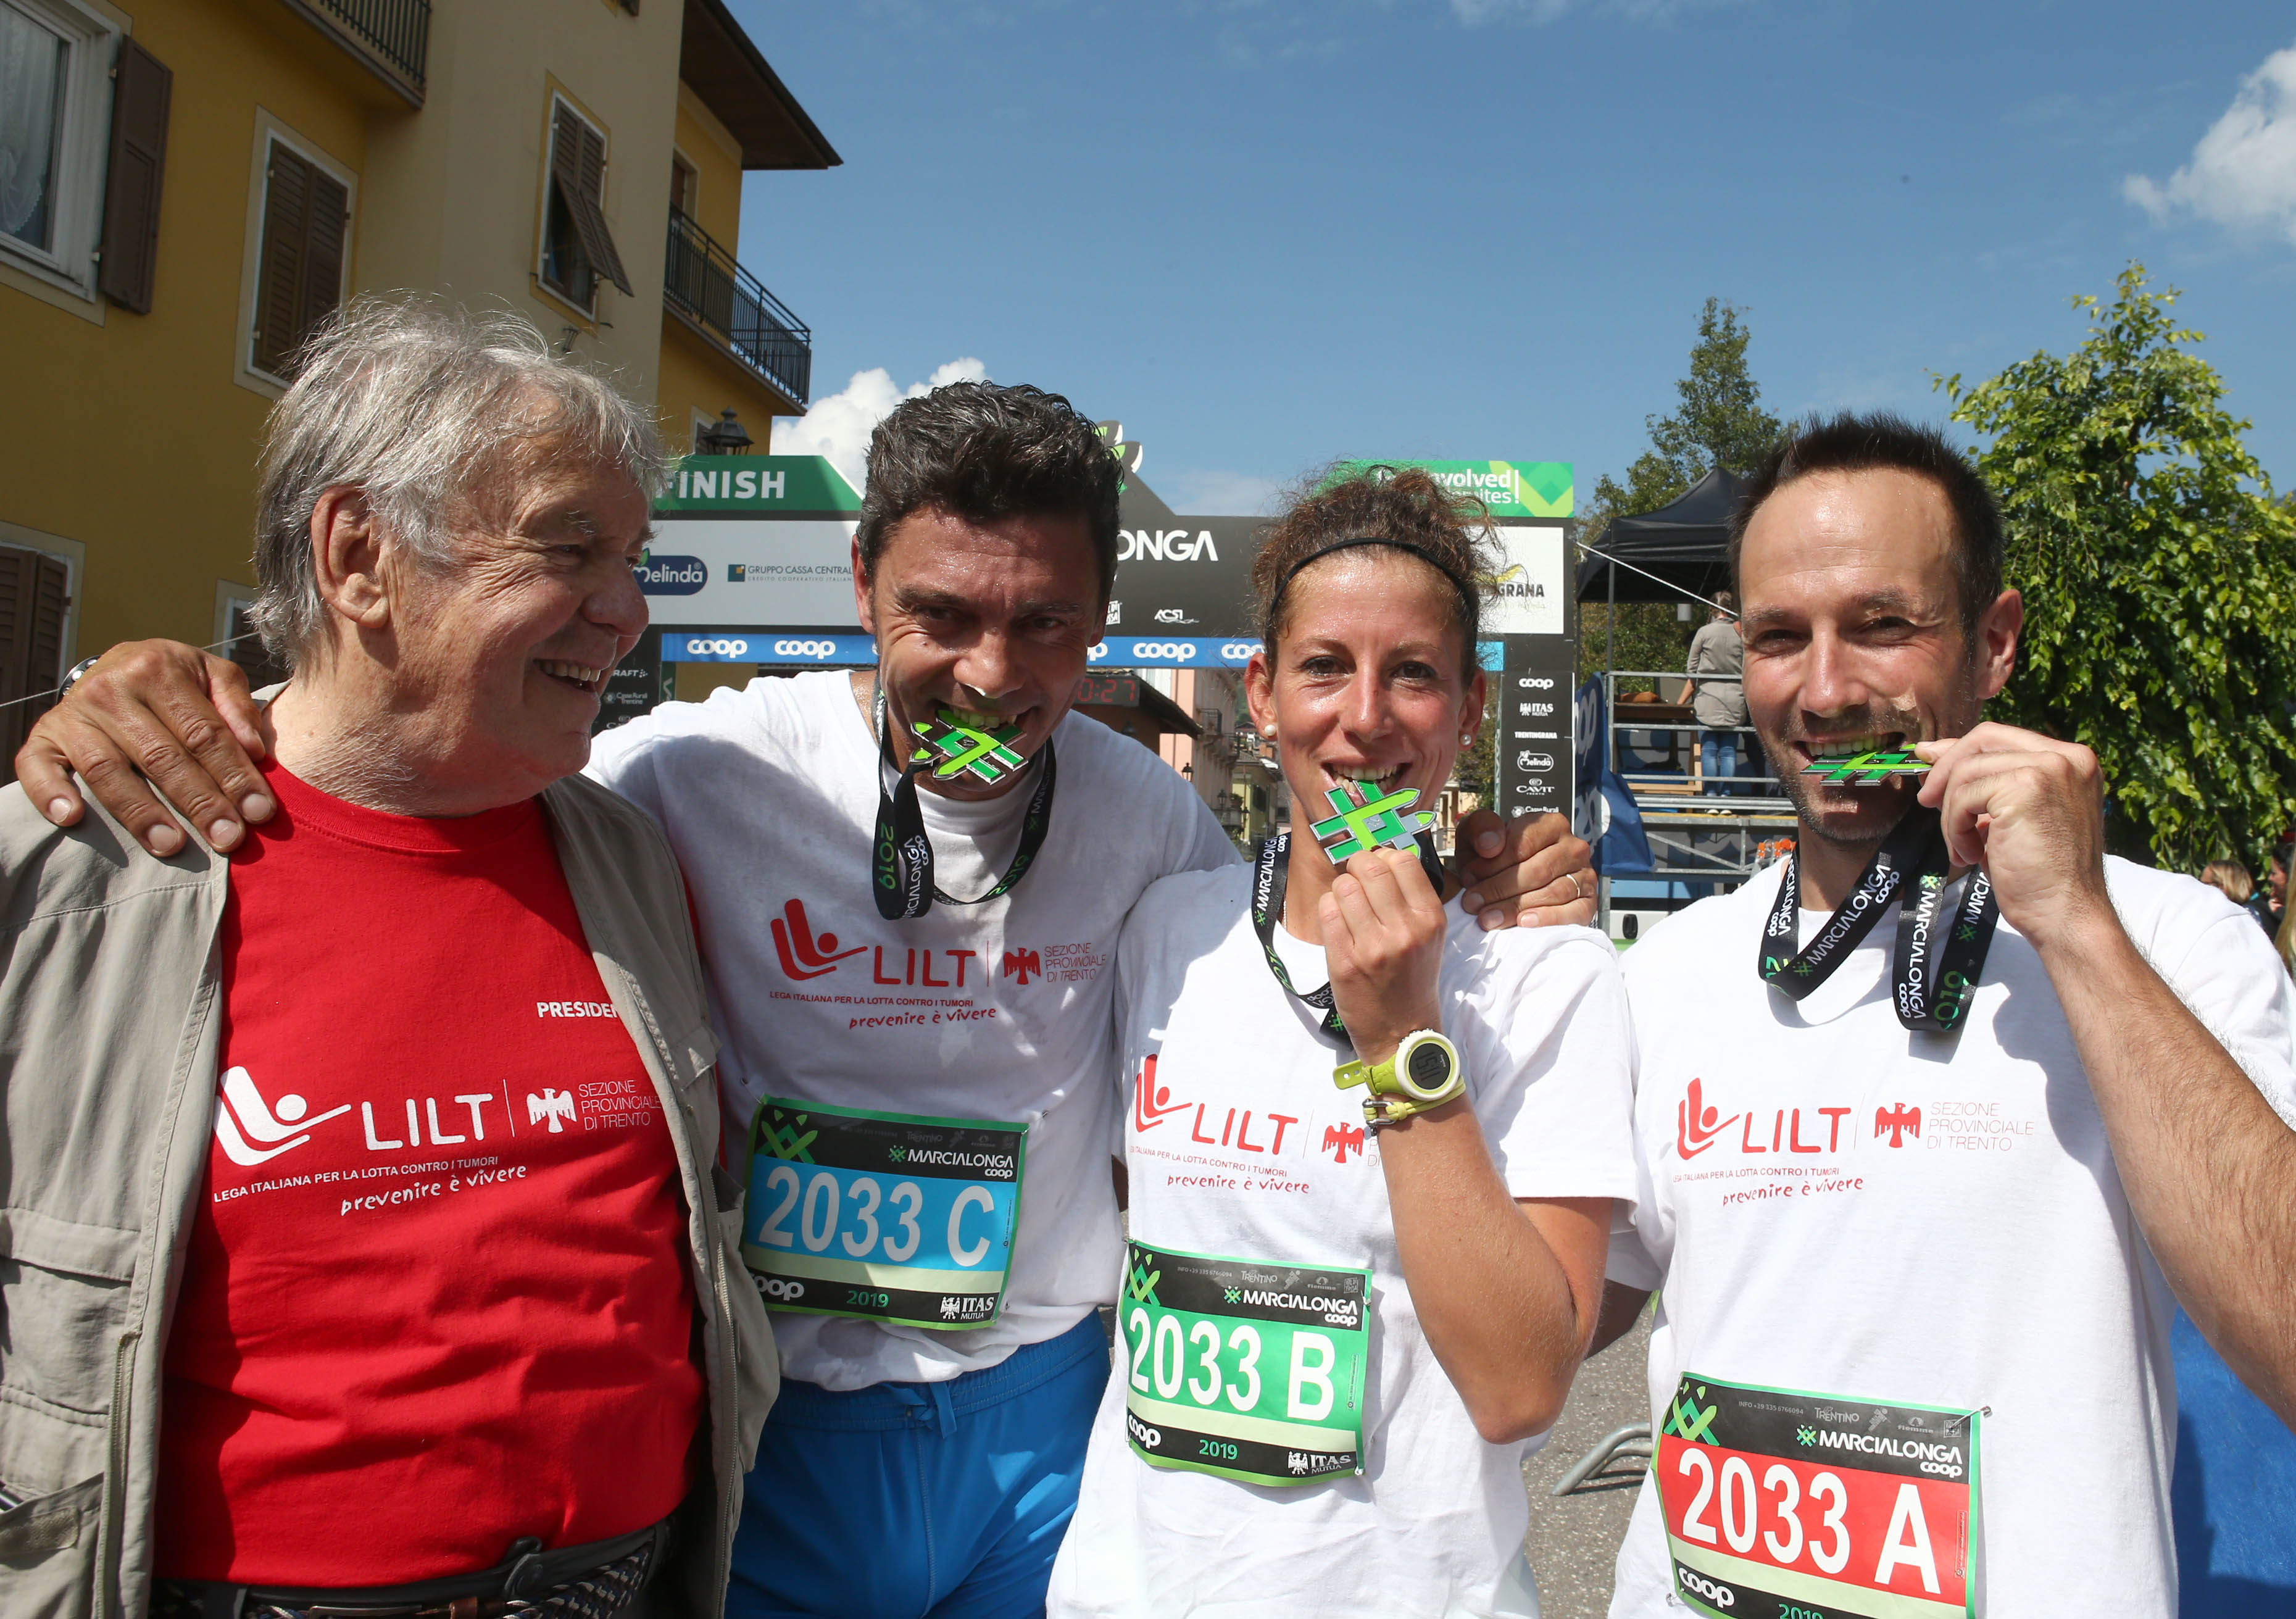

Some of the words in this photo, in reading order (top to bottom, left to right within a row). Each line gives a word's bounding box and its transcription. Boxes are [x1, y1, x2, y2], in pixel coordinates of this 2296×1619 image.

[748, 566, 784, 574] GRUPPO
[785, 566, 813, 574] CASSA
[687, 639, 747, 658] coop
[774, 639, 836, 659] coop
[1133, 643, 1196, 662] coop
[1518, 678, 1554, 690] coop
[1532, 703, 1554, 712] ITAS
[1520, 757, 1552, 766] Melinda
[1516, 785, 1555, 793] CAVIT
[1277, 835, 1288, 852] coop
[879, 822, 896, 889] 2019
[1875, 871, 1900, 904] coop
[1807, 863, 1892, 965] MARCIALONGA
[1768, 912, 1779, 937] coop
[1044, 943, 1091, 957] SEZIONE
[1909, 891, 1936, 1018] MARCIALONGA
[874, 946, 976, 988] LILT
[1046, 954, 1106, 969] PROVINCIALE
[1047, 972, 1057, 983] DI
[1060, 968, 1096, 982] TRENTO
[770, 991, 791, 1000] LEGA
[793, 993, 833, 1004] ITALIANA
[834, 996, 852, 1004] PER
[854, 996, 865, 1004] LA
[867, 997, 894, 1005] LOTTA
[896, 998, 932, 1007] CONTRO
[939, 999, 973, 1007] TUMORI
[1899, 983, 1911, 1018] coop
[849, 1012, 925, 1030] prevenire
[932, 1010, 941, 1023] è
[947, 1007, 997, 1022] vivere
[578, 1080, 637, 1097] SEZIONE
[1931, 1102, 2000, 1116] SEZIONE
[361, 1093, 494, 1151] LILT
[584, 1117, 597, 1131] DI
[599, 1112, 651, 1129] TRENTO
[1192, 1102, 1299, 1155] LILT
[1742, 1107, 1852, 1154] LILT
[1929, 1118, 2035, 1135] PROVINCIALE
[1927, 1135, 1942, 1149] DI
[1948, 1136, 2012, 1151] TRENTO
[907, 1149, 1013, 1168] MARCIALONGA
[1157, 1151, 1170, 1159] PER
[1172, 1152, 1181, 1161] LA
[1183, 1155, 1207, 1165] LOTTA
[1210, 1159, 1246, 1172] CONTRO
[1253, 1165, 1287, 1177] TUMORI
[214, 1188, 249, 1203] LEGA
[251, 1176, 312, 1194] ITALIANA
[314, 1171, 338, 1184] PER
[343, 1169, 360, 1180] LA
[362, 1165, 399, 1178] LOTTA
[401, 1161, 449, 1175] CONTRO
[457, 1156, 499, 1169] TUMORI
[984, 1168, 1013, 1179] coop
[1710, 1171, 1724, 1179] PER
[1725, 1170, 1734, 1178] LA
[1736, 1168, 1758, 1178] LOTTA
[1760, 1167, 1803, 1176] CONTRO
[1811, 1167, 1840, 1176] TUMORI
[340, 1181, 442, 1217] prevenire
[449, 1175, 460, 1192] è
[467, 1163, 527, 1188] vivere
[1167, 1174, 1236, 1190] prevenire
[1244, 1176, 1252, 1190] è
[1258, 1178, 1310, 1194] vivere
[1723, 1183, 1793, 1207] prevenire
[1802, 1181, 1811, 1196] è
[1816, 1177, 1864, 1192] vivere
[759, 1166, 923, 1262] 2033
[947, 1185, 995, 1267] C
[1241, 1270, 1278, 1284] TRENTINO
[846, 1289, 889, 1308] 2019
[962, 1296, 995, 1313] ITAS
[1243, 1289, 1358, 1315] MARCIALONGA
[960, 1312, 984, 1320] MUTUA
[1325, 1313, 1358, 1327] coop
[1129, 1307, 1262, 1412] 2033
[1286, 1330, 1336, 1421] B
[1739, 1400, 1753, 1409] INFO
[1753, 1402, 1765, 1410] +39
[1765, 1403, 1778, 1412] 335
[1778, 1405, 1804, 1415] 6766094
[1814, 1407, 1860, 1423] TRENTINO
[1128, 1414, 1162, 1449] coop
[1199, 1439, 1238, 1460] 2019
[1819, 1430, 1963, 1464] MARCIALONGA
[1310, 1453, 1352, 1467] ITAS
[1311, 1464, 1342, 1474] MUTUA
[1920, 1461, 1963, 1478] coop
[1678, 1447, 1850, 1575] 2033
[1874, 1483, 1941, 1594] A
[1678, 1567, 1735, 1609] coop
